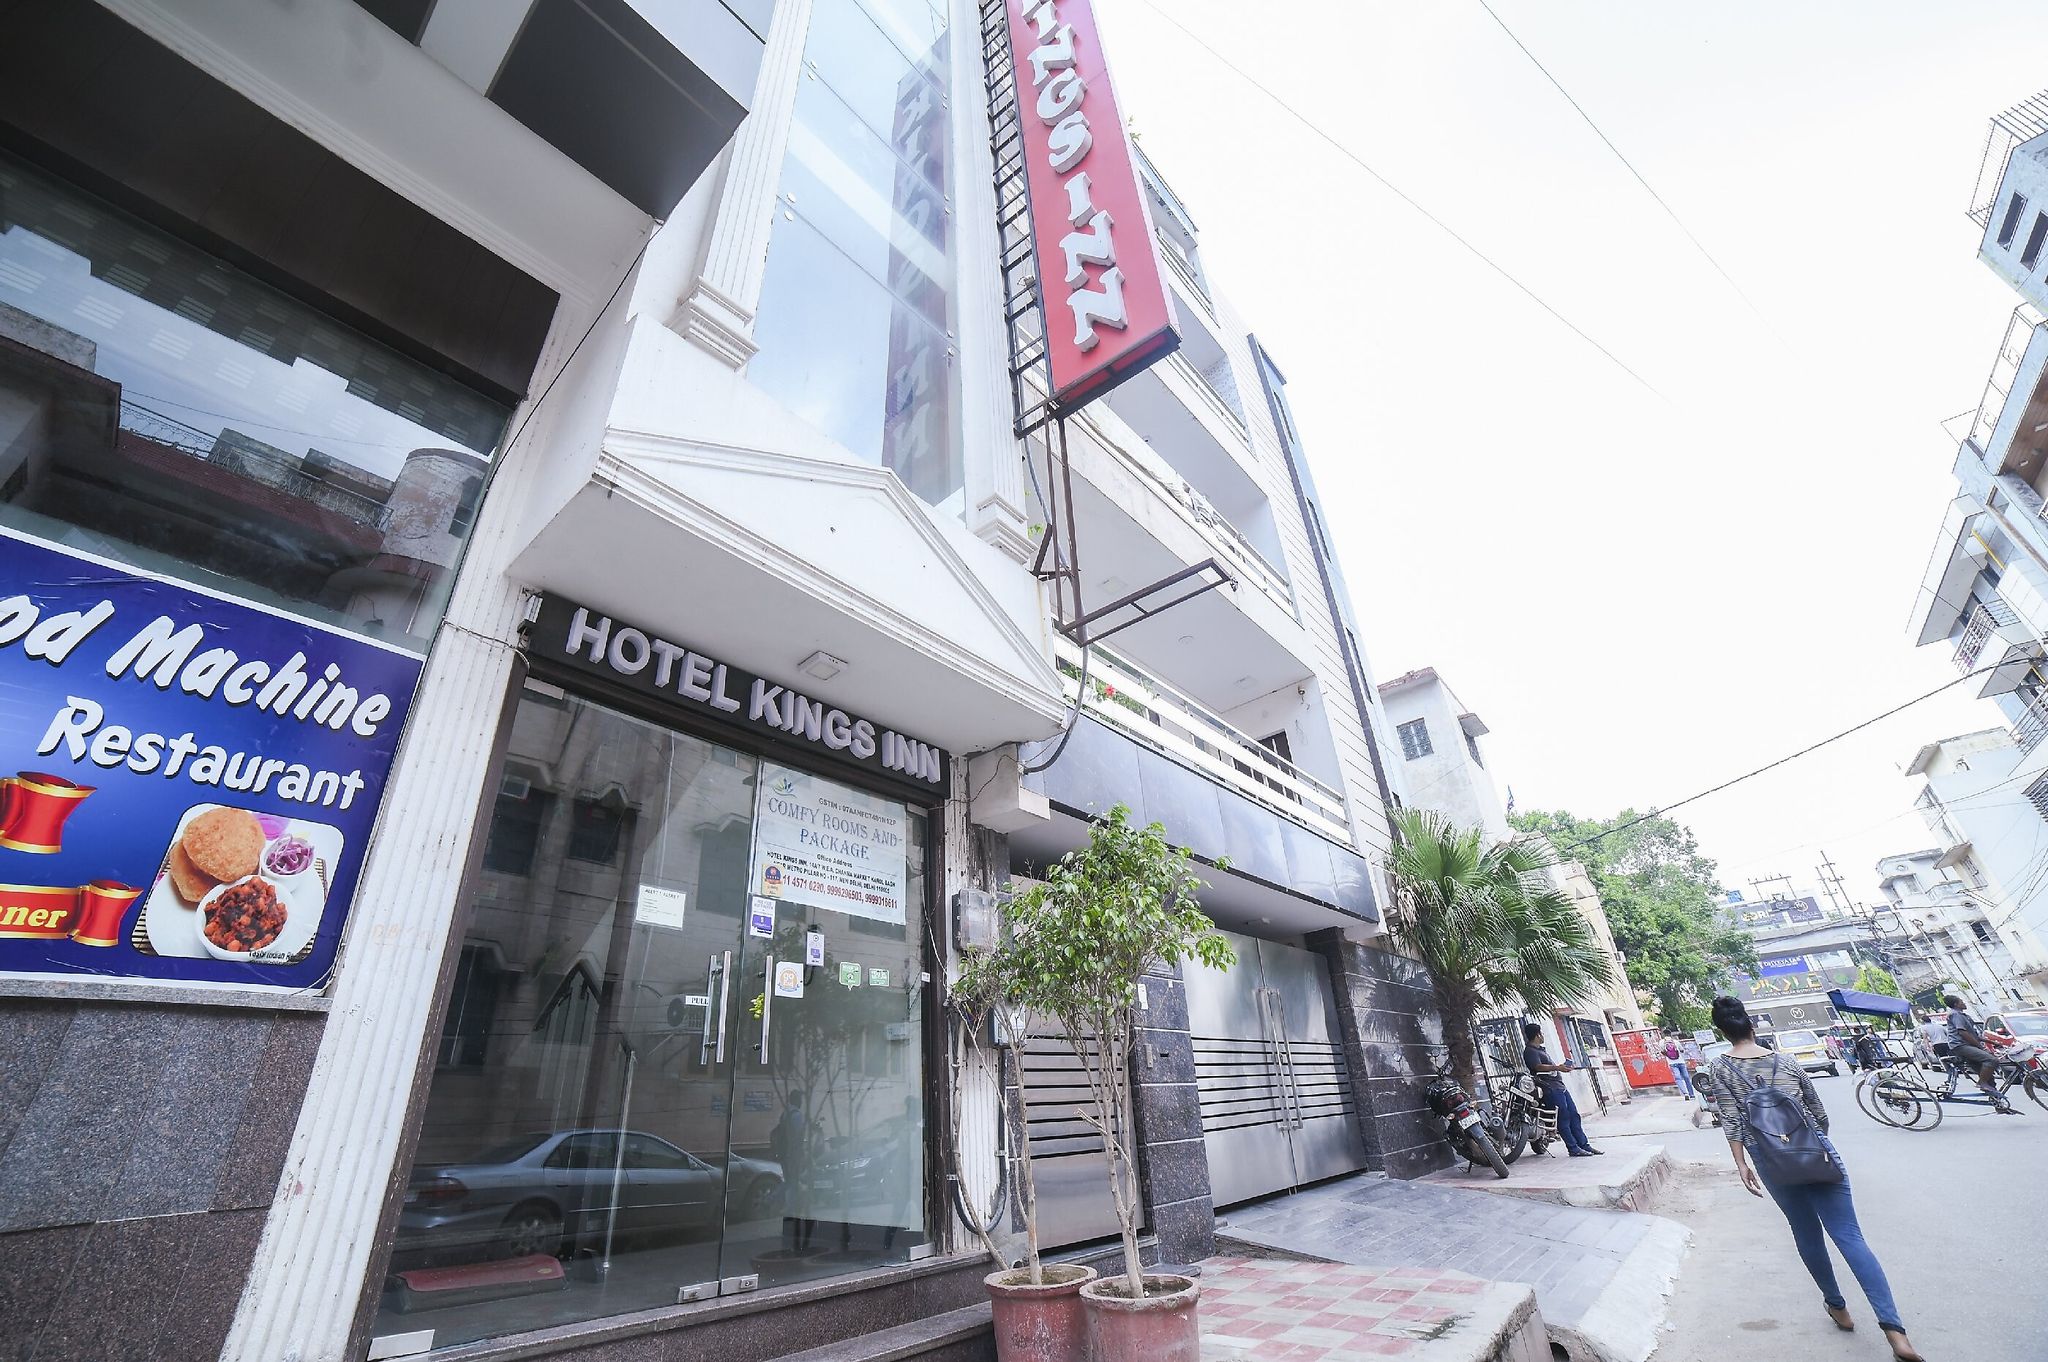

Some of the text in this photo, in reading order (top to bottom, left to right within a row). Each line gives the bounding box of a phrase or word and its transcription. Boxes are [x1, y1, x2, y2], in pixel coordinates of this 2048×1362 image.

[1021, 0, 1128, 354] INGS INN
[106, 615, 391, 737] Machine
[565, 607, 941, 784] HOTEL KINGS INN
[36, 696, 365, 810] Restaurant
[768, 797, 820, 824] COMFY
[822, 813, 869, 840] ROOMS
[800, 828, 870, 860] PACKAGE
[0, 905, 68, 929] ner
[691, 997, 709, 1005] PULL
